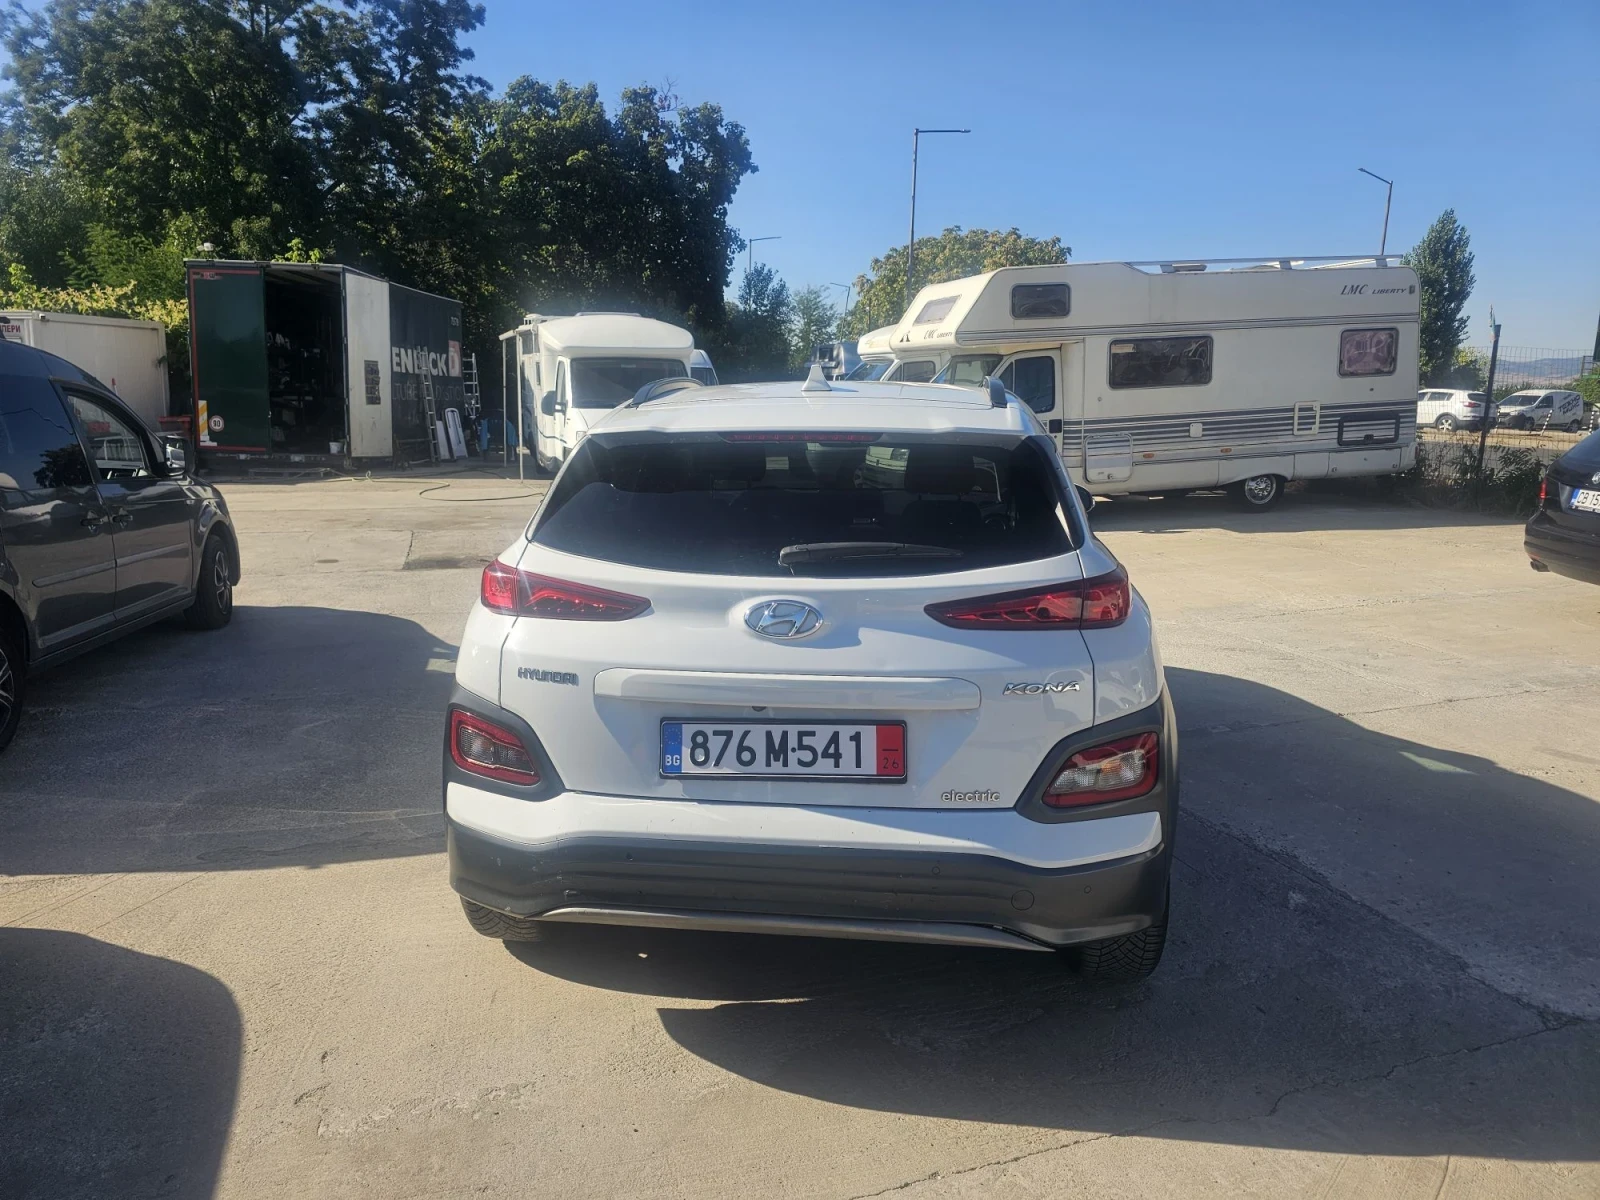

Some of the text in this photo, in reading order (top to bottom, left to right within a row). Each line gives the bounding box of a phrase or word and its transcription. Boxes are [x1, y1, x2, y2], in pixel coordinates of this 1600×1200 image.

[1340, 284, 1368, 295] LMC
[1590, 493, 1600, 506] 15
[517, 666, 580, 687] HYUNDAI
[1003, 681, 1080, 696] KONA
[689, 729, 757, 768] 876
[665, 755, 680, 766] BG
[882, 757, 899, 769] 26
[941, 788, 1000, 802] electric
